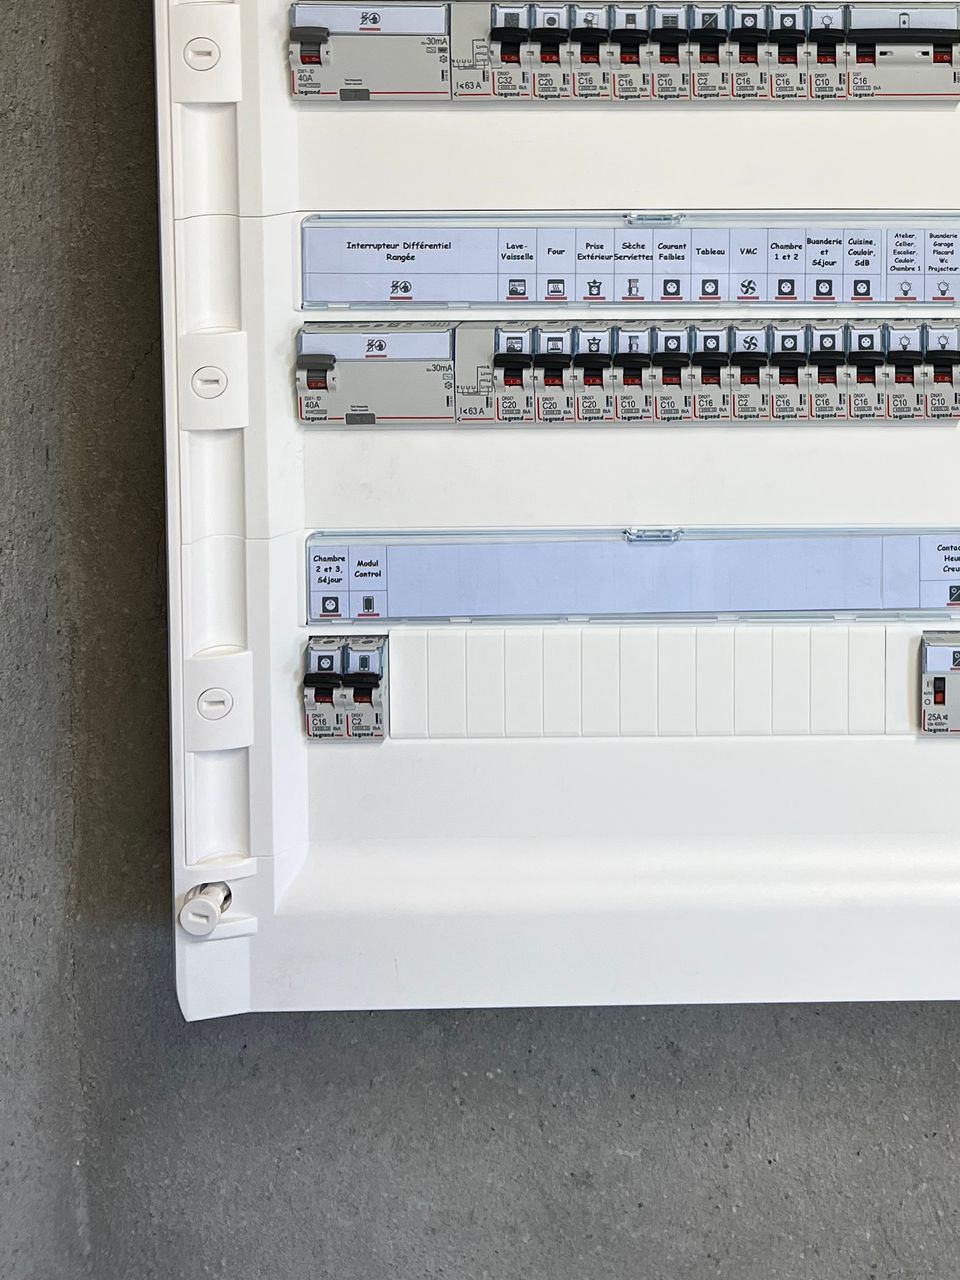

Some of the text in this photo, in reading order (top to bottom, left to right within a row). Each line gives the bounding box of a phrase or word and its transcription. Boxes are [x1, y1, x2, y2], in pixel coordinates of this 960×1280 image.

[426, 37, 448, 46] 30mA
[538, 78, 553, 86] C20
[848, 238, 876, 246] Cuisine,
[933, 241, 953, 250] Garage
[347, 242, 399, 251] Interrupteur
[387, 253, 415, 262] Rangée
[578, 253, 615, 261] Extérieur
[614, 253, 653, 261] Serviettes
[812, 259, 837, 267] Séjour
[305, 401, 320, 409] 40A
[621, 400, 636, 408] C10
[854, 398, 868, 406] C16
[931, 398, 946, 406] C10
[318, 576, 342, 584] Séjour
[927, 713, 942, 721] 25A
